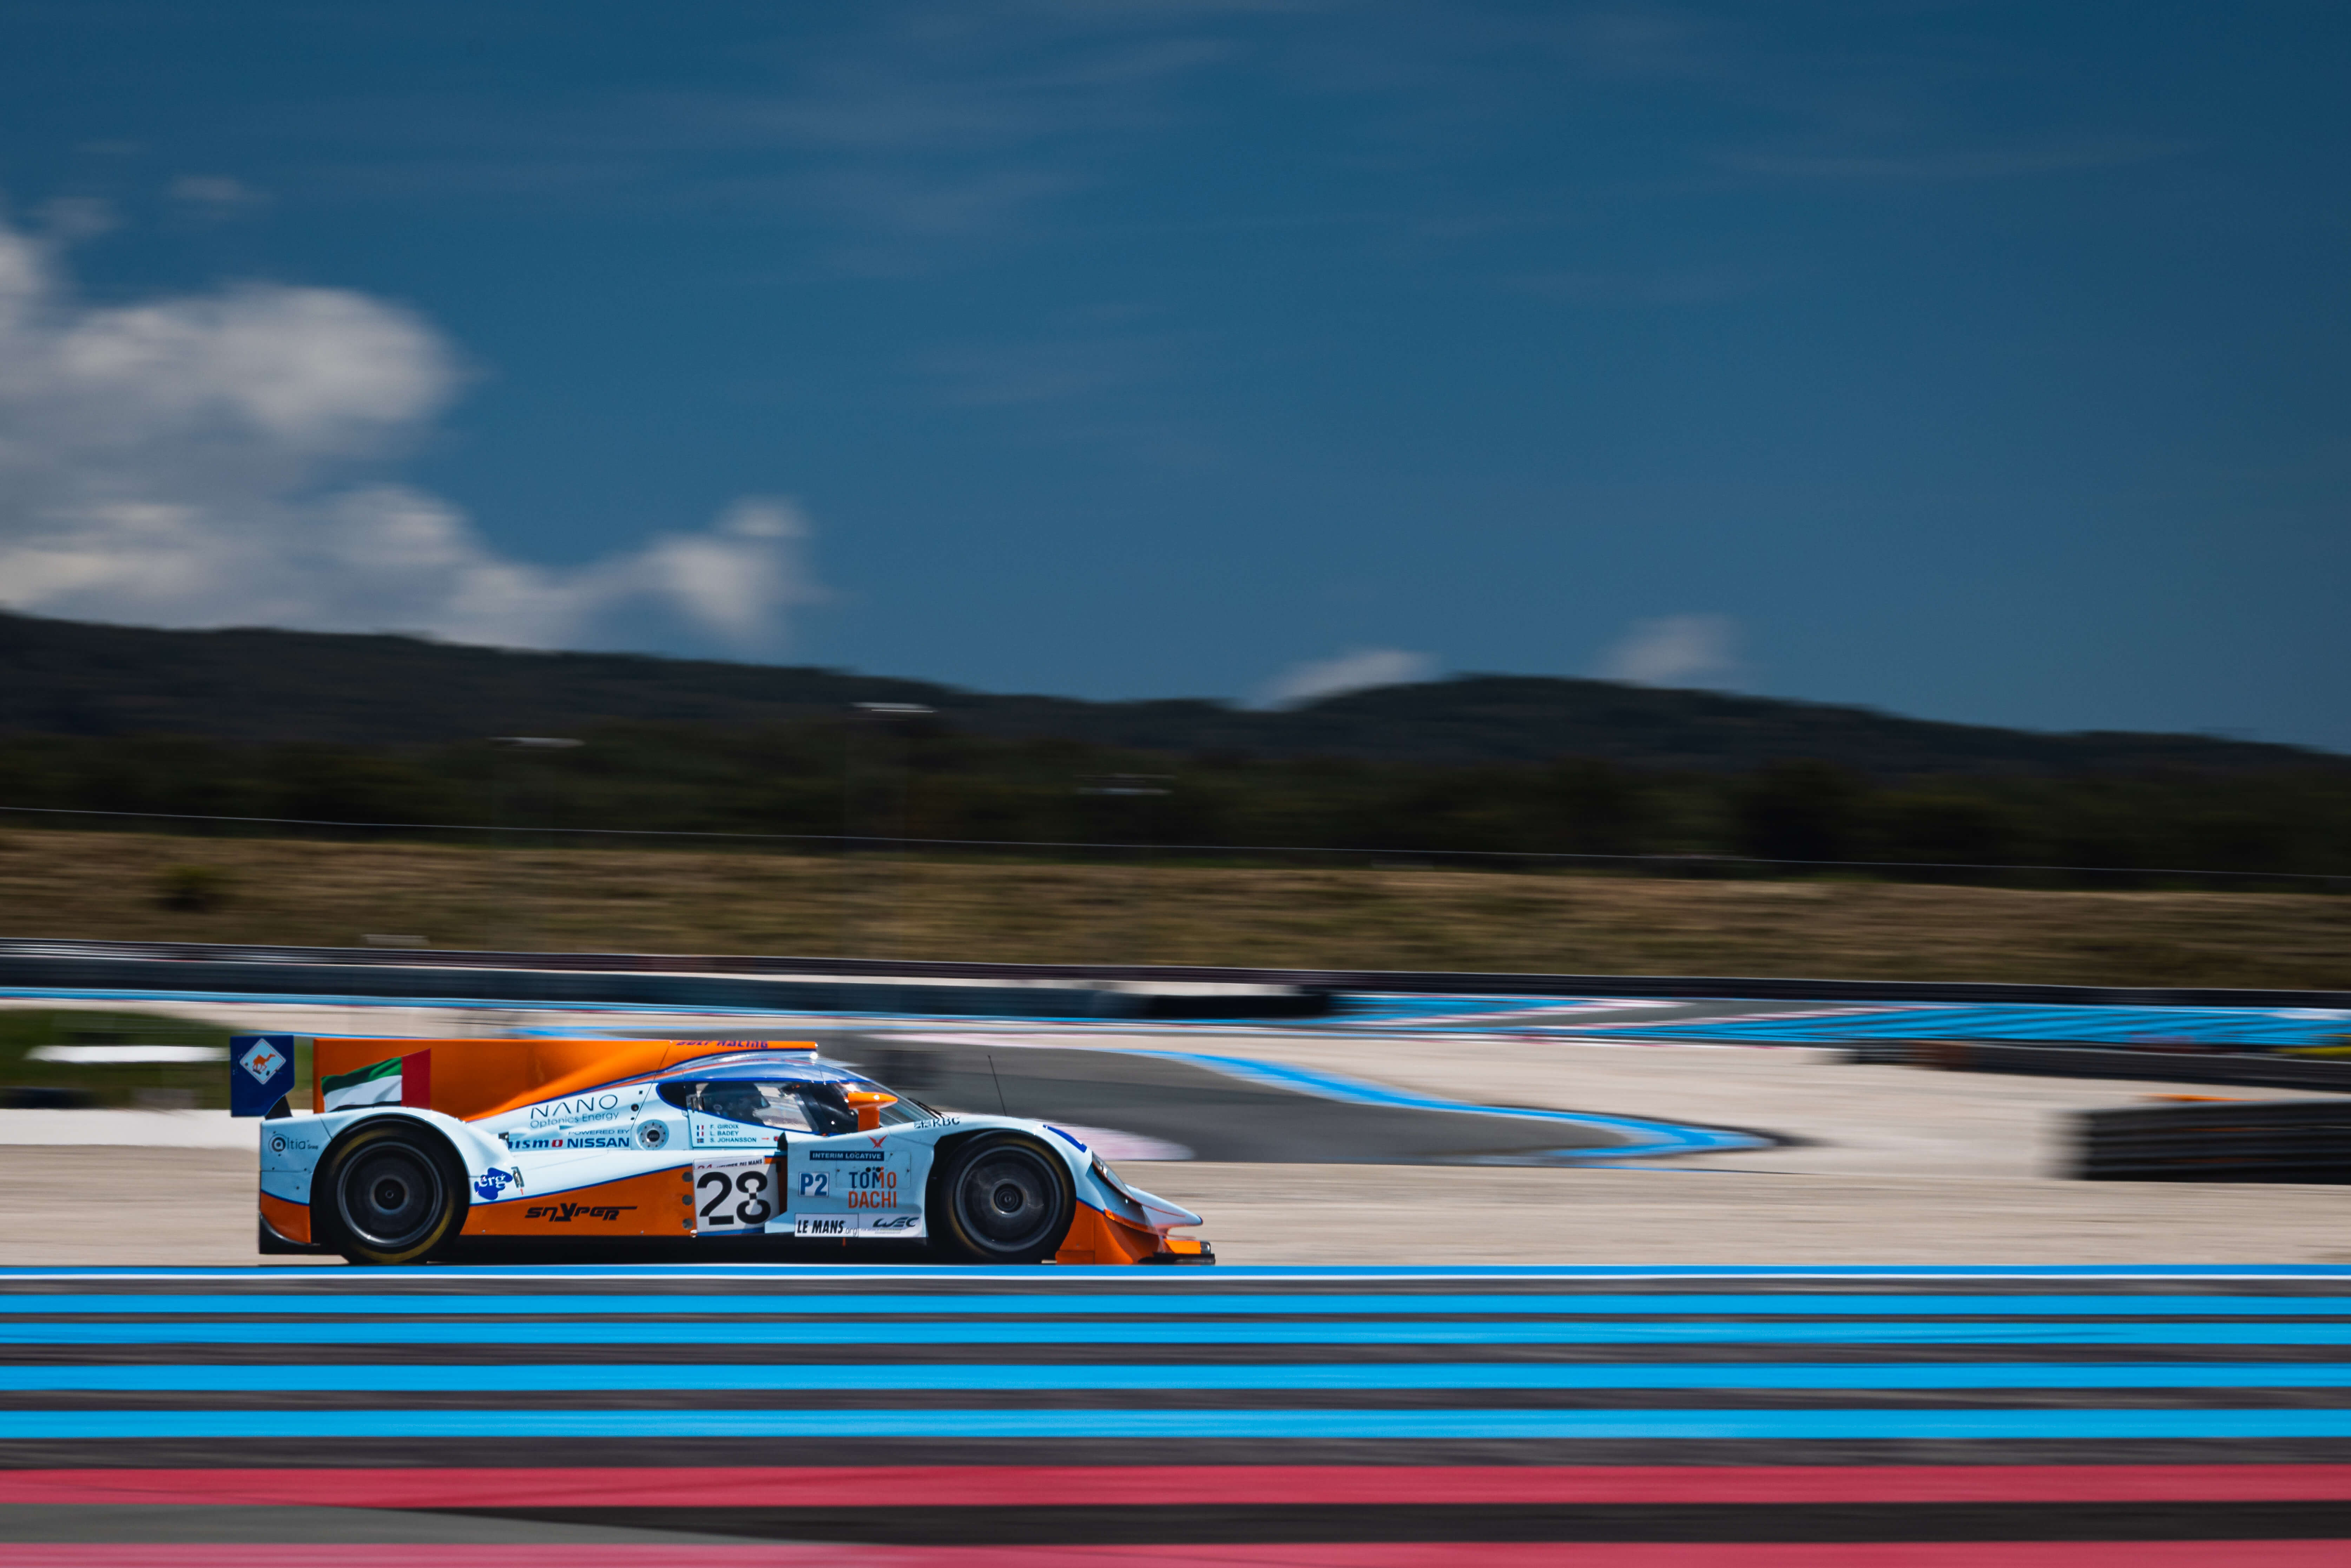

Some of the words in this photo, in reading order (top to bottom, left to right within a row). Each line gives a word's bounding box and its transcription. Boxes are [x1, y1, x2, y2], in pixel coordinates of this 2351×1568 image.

[531, 1094, 618, 1119] NANO
[530, 1117, 578, 1129] Optonics
[582, 1111, 619, 1122] Energy
[567, 1138, 630, 1148] NISSAN
[800, 1173, 828, 1197] P2
[848, 1171, 897, 1189] TOMO
[848, 1191, 897, 1208] DACHI
[797, 1219, 809, 1234] LE
[872, 1216, 920, 1228] WEC
